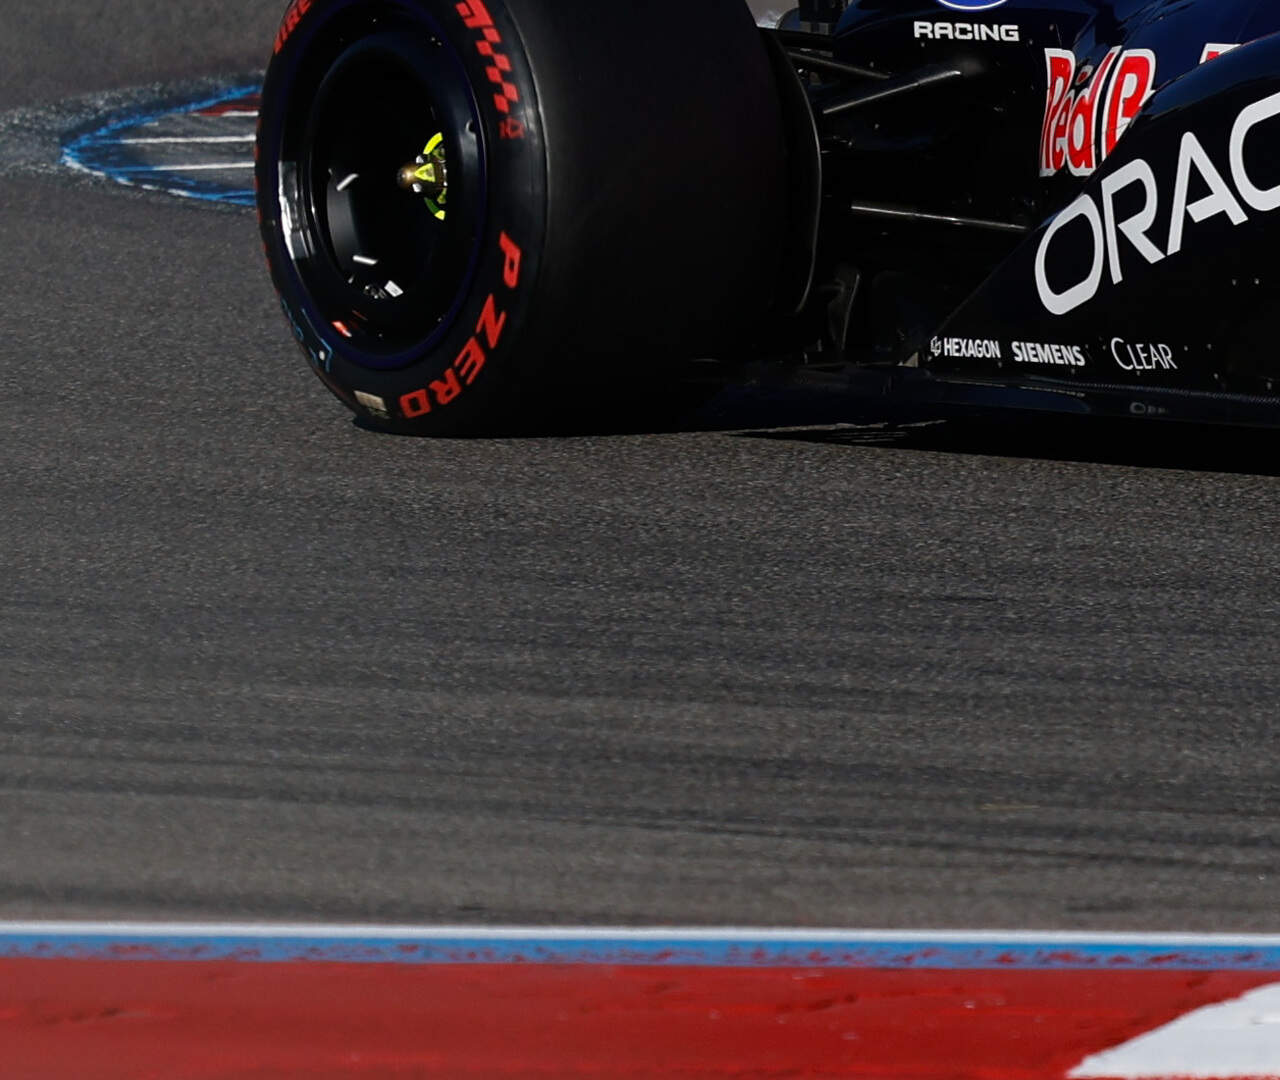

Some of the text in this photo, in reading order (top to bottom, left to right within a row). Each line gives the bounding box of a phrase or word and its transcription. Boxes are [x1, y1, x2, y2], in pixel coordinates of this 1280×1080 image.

[913, 21, 1020, 42] RACING
[1039, 45, 1123, 177] Red
[400, 231, 521, 418] P ZERO
[943, 336, 1000, 359] HEXAGON
[1011, 341, 1085, 367] SIEMENS
[1111, 337, 1178, 370] CLEAR
